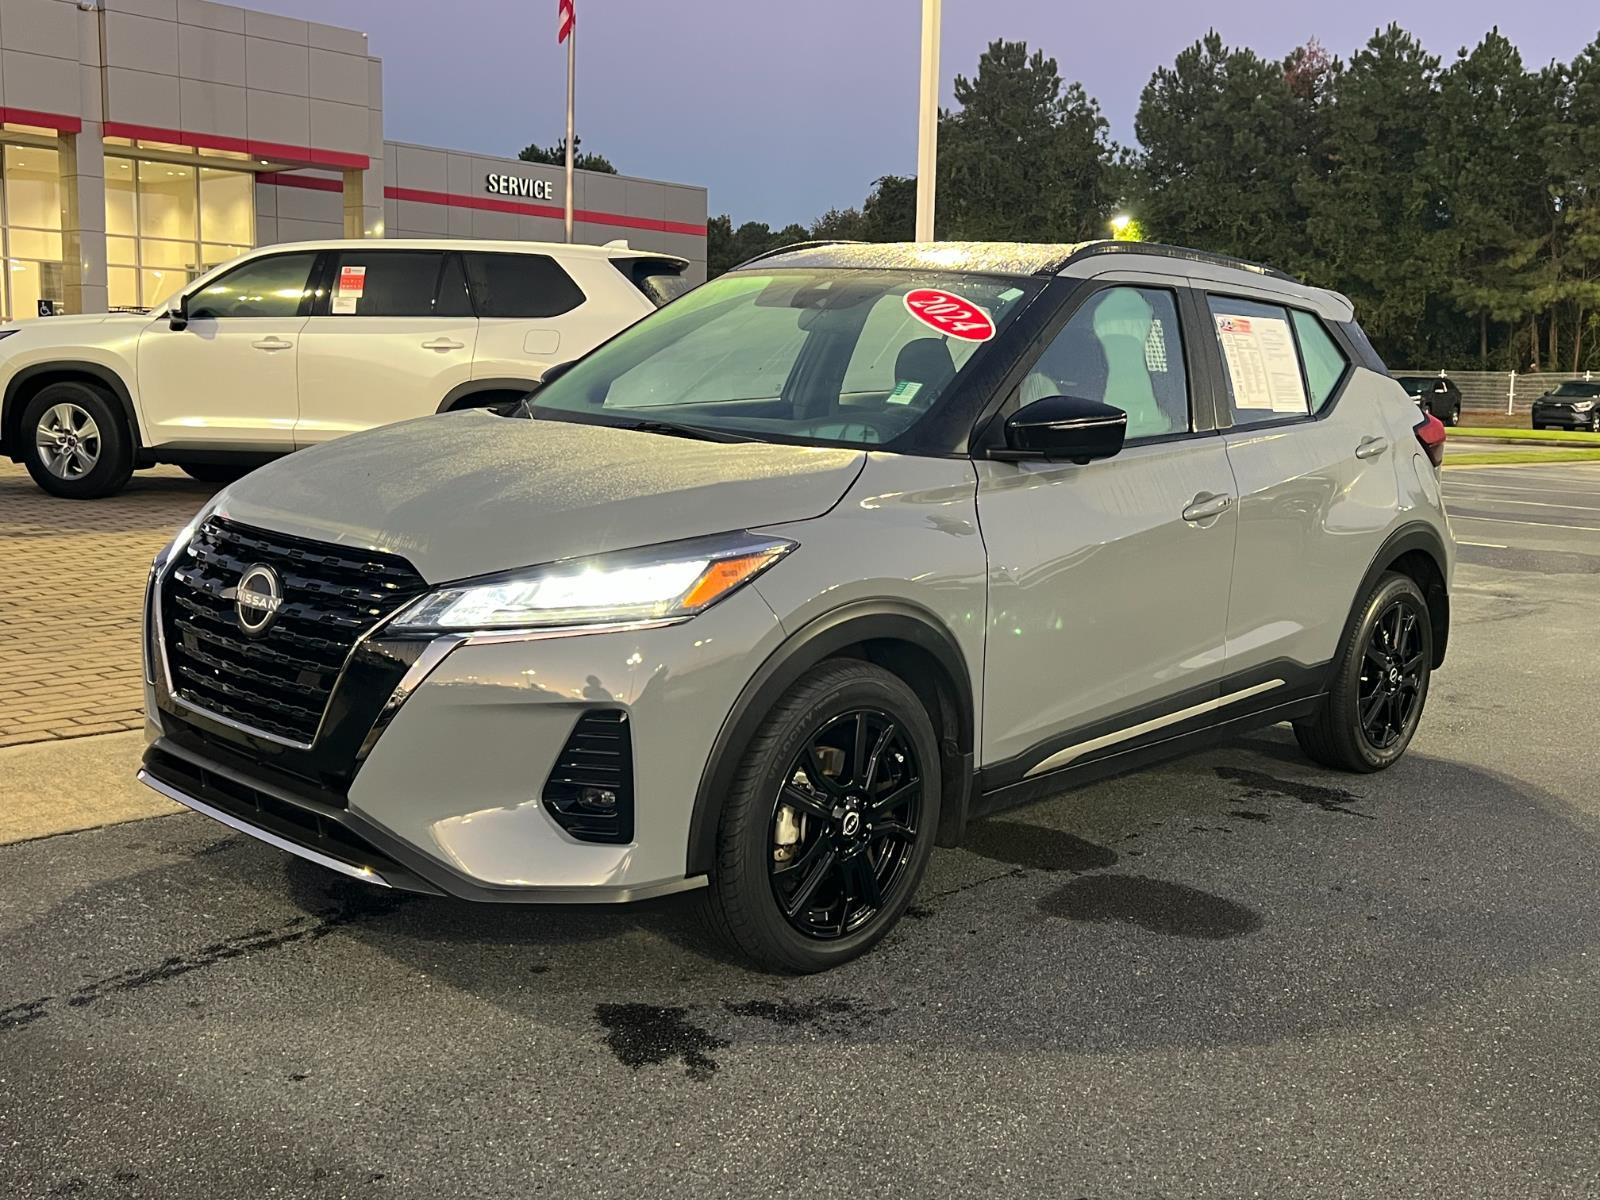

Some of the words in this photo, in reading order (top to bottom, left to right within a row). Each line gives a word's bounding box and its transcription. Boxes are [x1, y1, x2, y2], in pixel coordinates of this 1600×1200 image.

[487, 173, 553, 200] SERVICE
[910, 295, 990, 332] 2024
[238, 590, 278, 611] NISSAN
